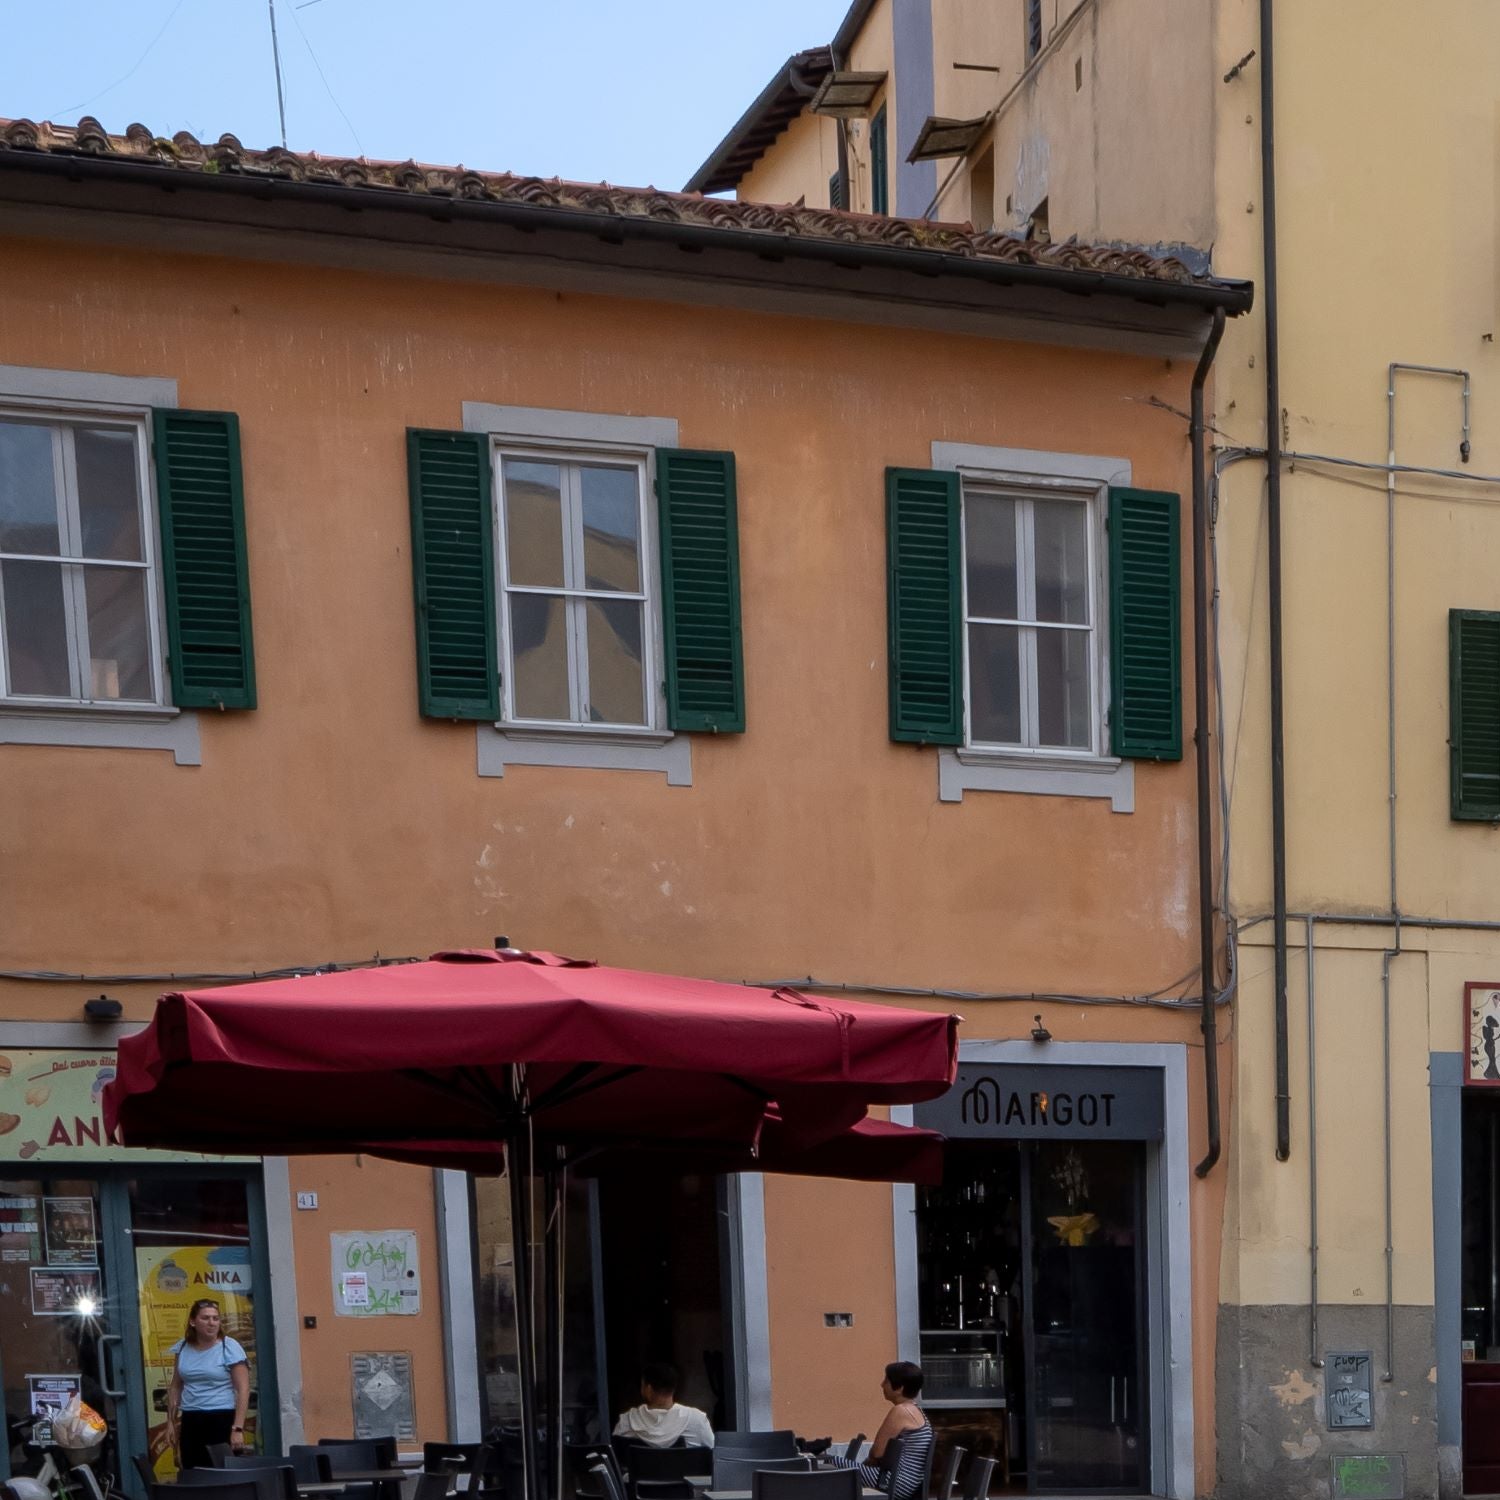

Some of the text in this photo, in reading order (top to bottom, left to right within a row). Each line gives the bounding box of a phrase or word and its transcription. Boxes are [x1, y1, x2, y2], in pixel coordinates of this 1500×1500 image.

[961, 1077, 1116, 1127] MARGOT
[299, 1194, 316, 1207] 41
[193, 1271, 242, 1284] ANIKA
